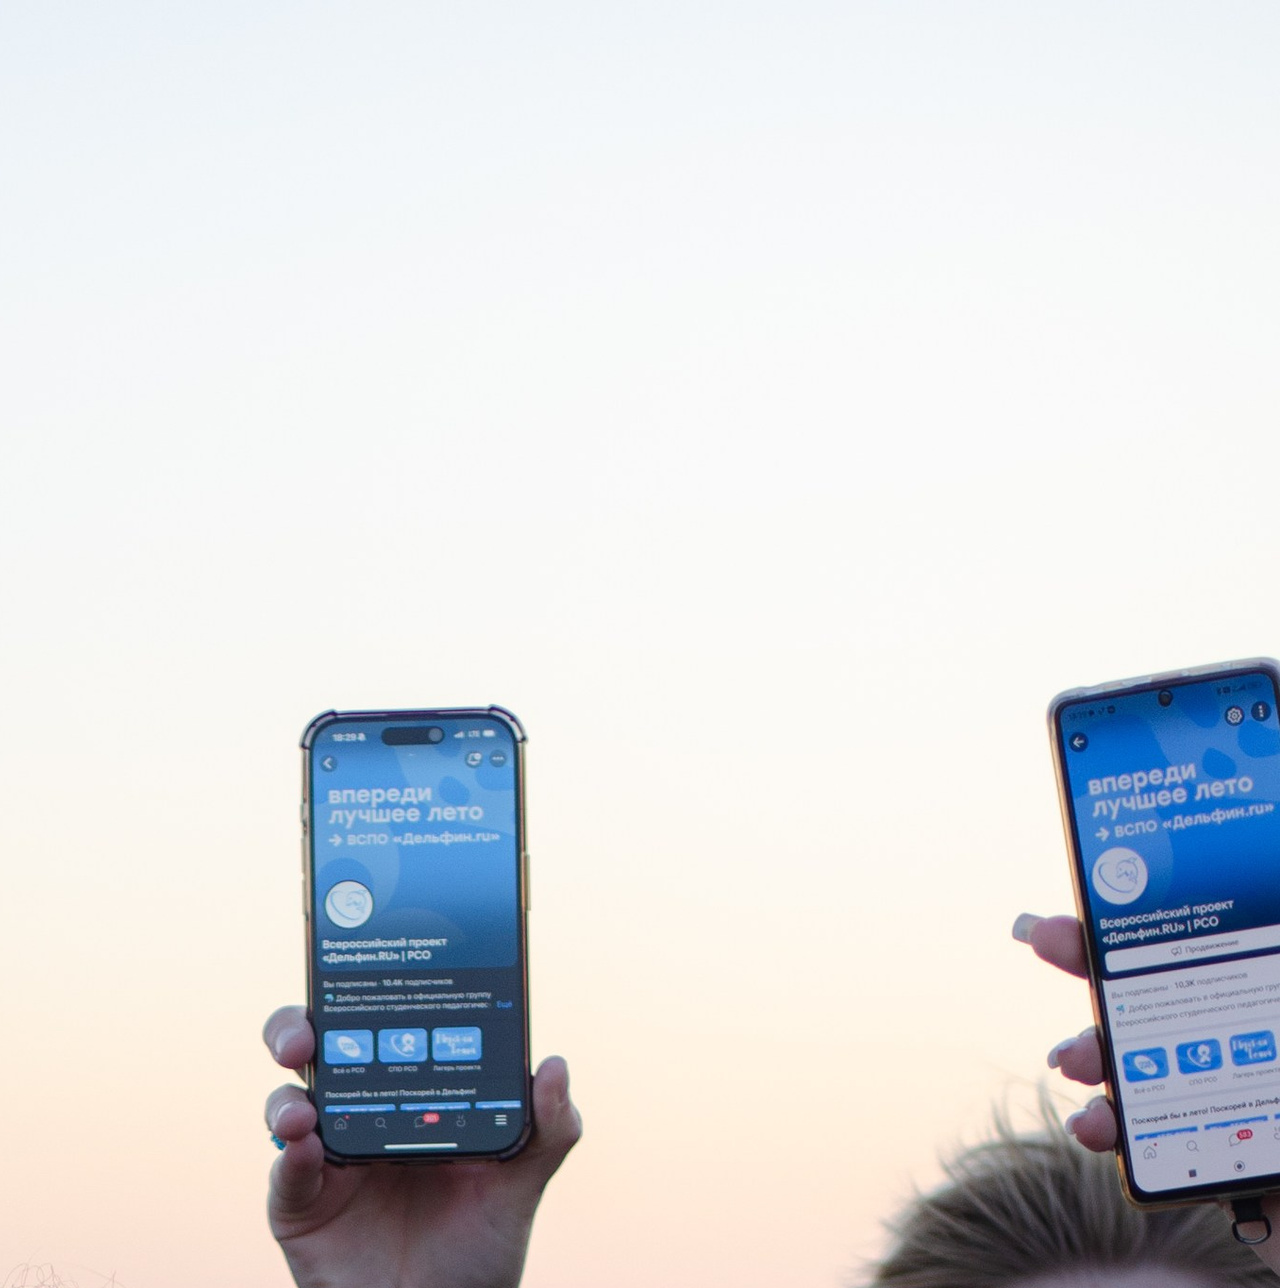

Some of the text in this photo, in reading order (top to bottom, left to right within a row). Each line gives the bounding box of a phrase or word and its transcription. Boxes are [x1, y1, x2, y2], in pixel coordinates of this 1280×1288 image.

[1087, 762, 1198, 799] впереди
[327, 787, 431, 807] впереди
[1090, 774, 1255, 823] лучшее лето
[328, 805, 483, 829] лучшее лето
[1114, 800, 1275, 838] ВСПО «Дельфин.ru»
[347, 830, 500, 846] ВСПО «Дельфин.ru»
[1099, 898, 1235, 930] Всероссийский проект
[322, 937, 447, 950] Всероссийский проект
[1101, 915, 1219, 946] «Дельфин.RU» РСО
[322, 950, 431, 963] «Дельфин.RU» РСО
